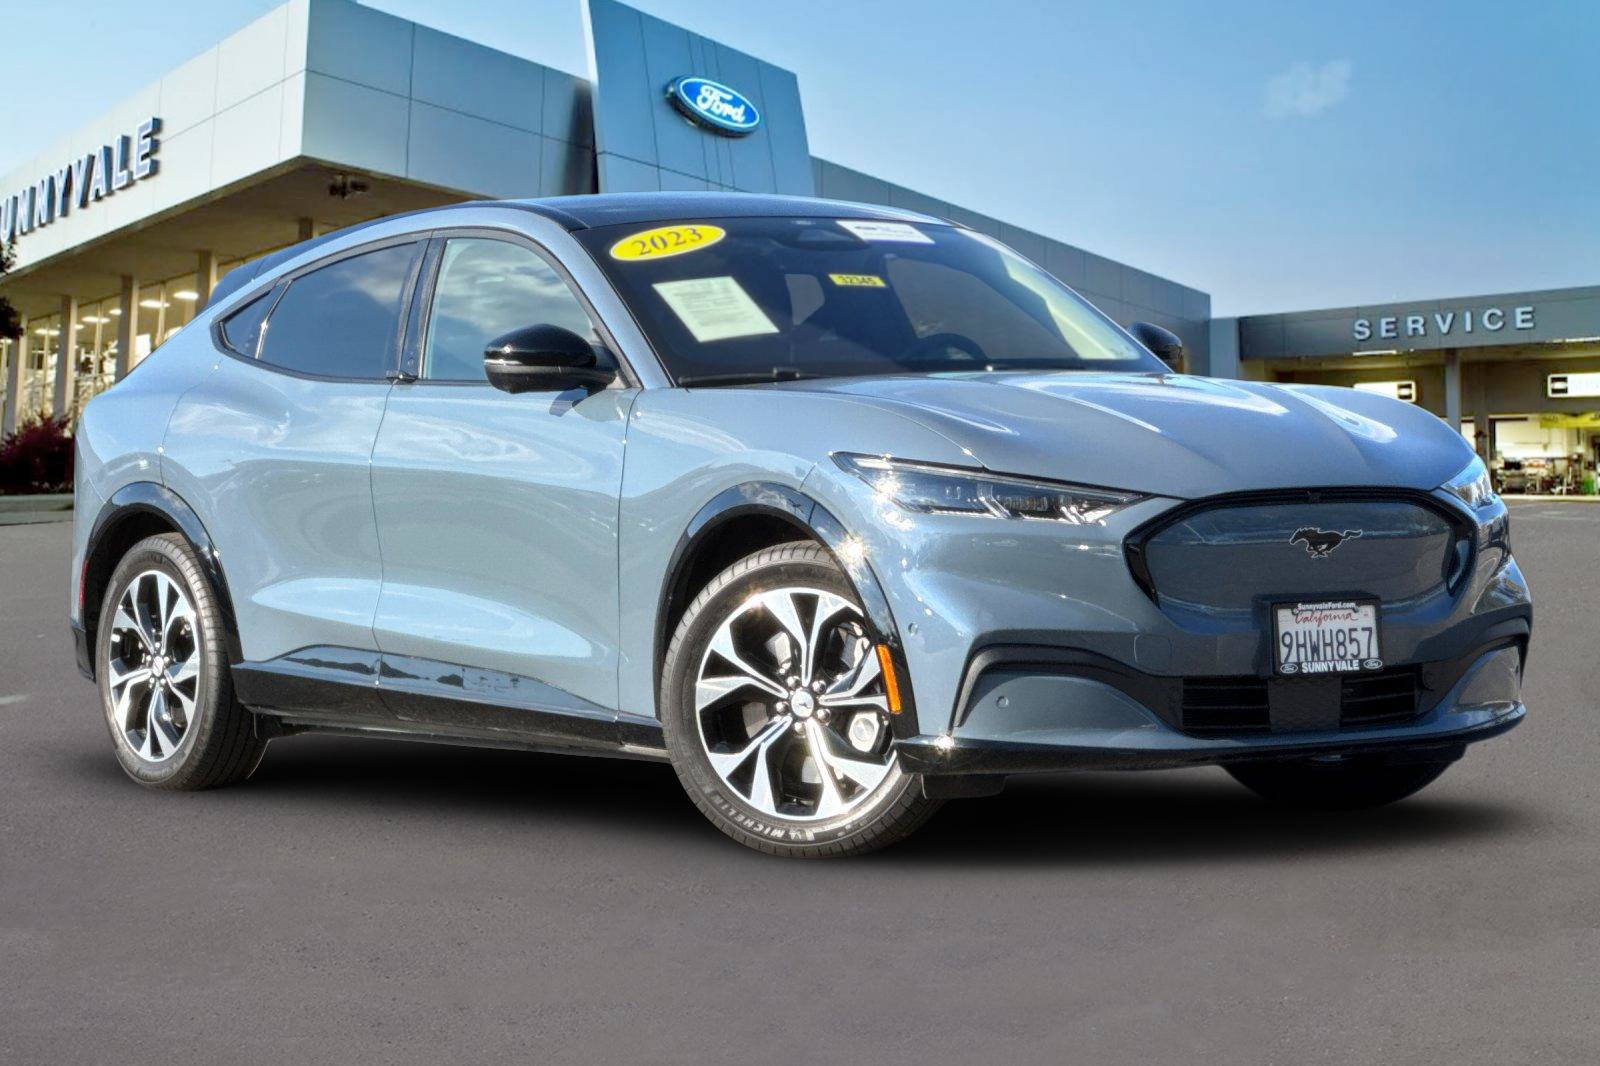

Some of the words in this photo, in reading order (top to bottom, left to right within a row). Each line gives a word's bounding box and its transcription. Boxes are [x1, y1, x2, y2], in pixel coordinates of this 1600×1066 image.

[696, 84, 746, 123] Ford
[0, 117, 162, 244] UNNYVALE
[632, 226, 703, 256] 2023
[1353, 306, 1535, 341] SERVICE
[1295, 610, 1359, 627] California
[1281, 627, 1373, 663] 9HWH857
[1301, 660, 1360, 674] SUNNYVALE
[710, 791, 785, 839] MICHELIN
